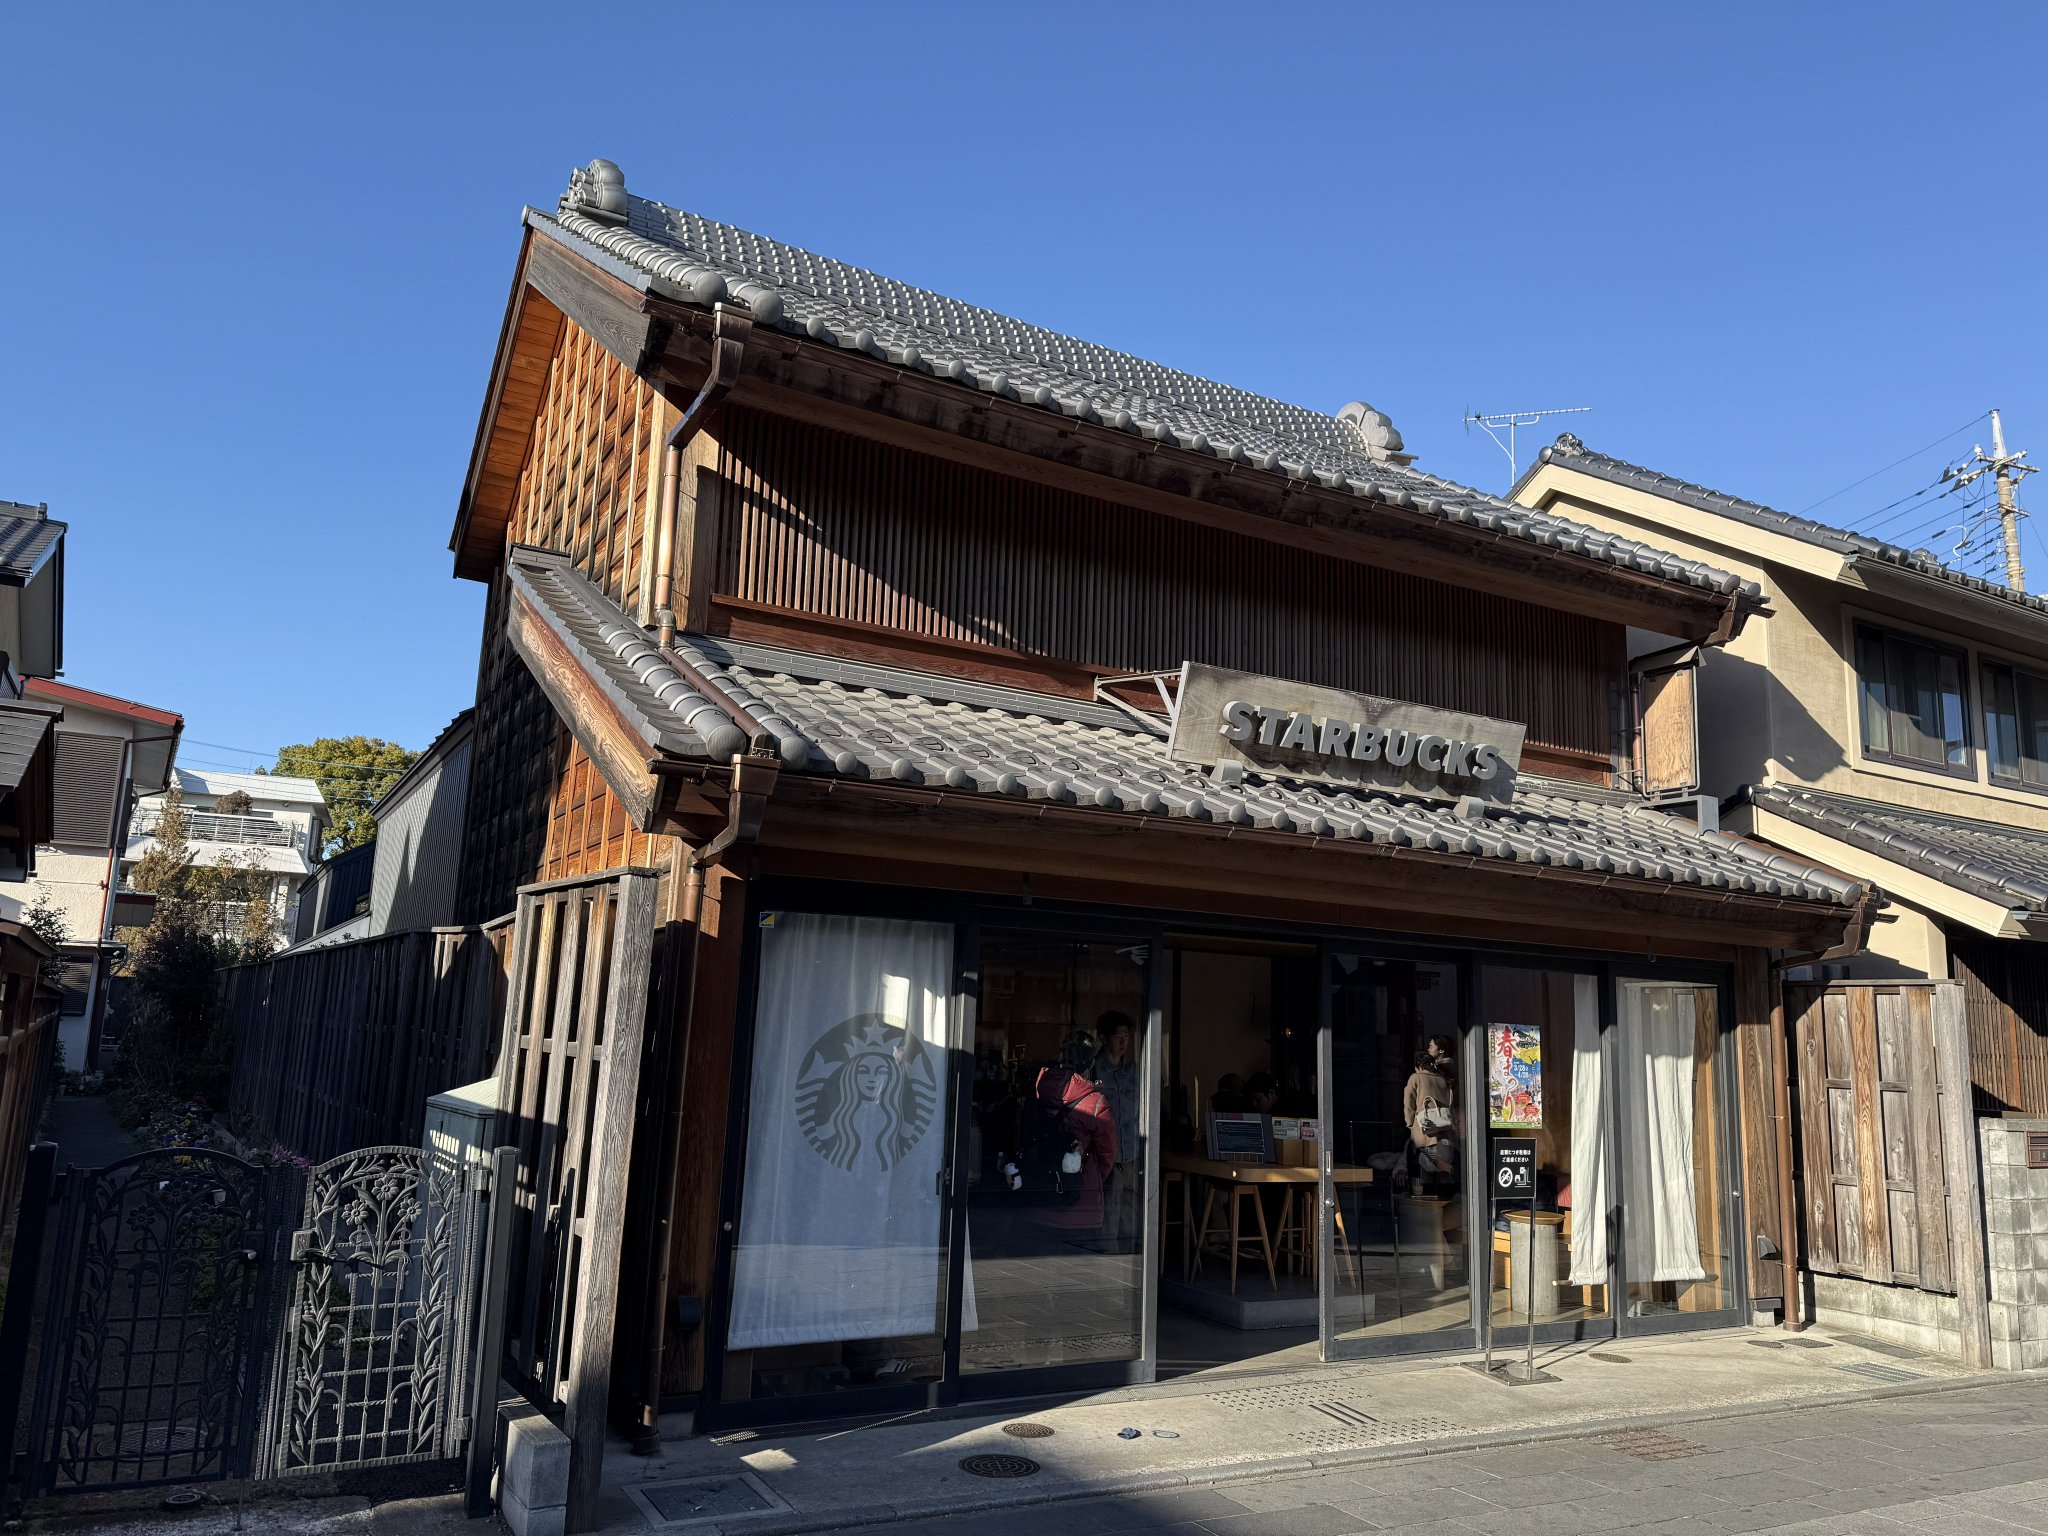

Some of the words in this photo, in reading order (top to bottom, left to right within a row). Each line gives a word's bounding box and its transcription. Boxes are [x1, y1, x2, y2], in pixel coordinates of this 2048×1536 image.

[1218, 700, 1500, 780] STARBUCKS
[1497, 1026, 1519, 1120] 春まつり
